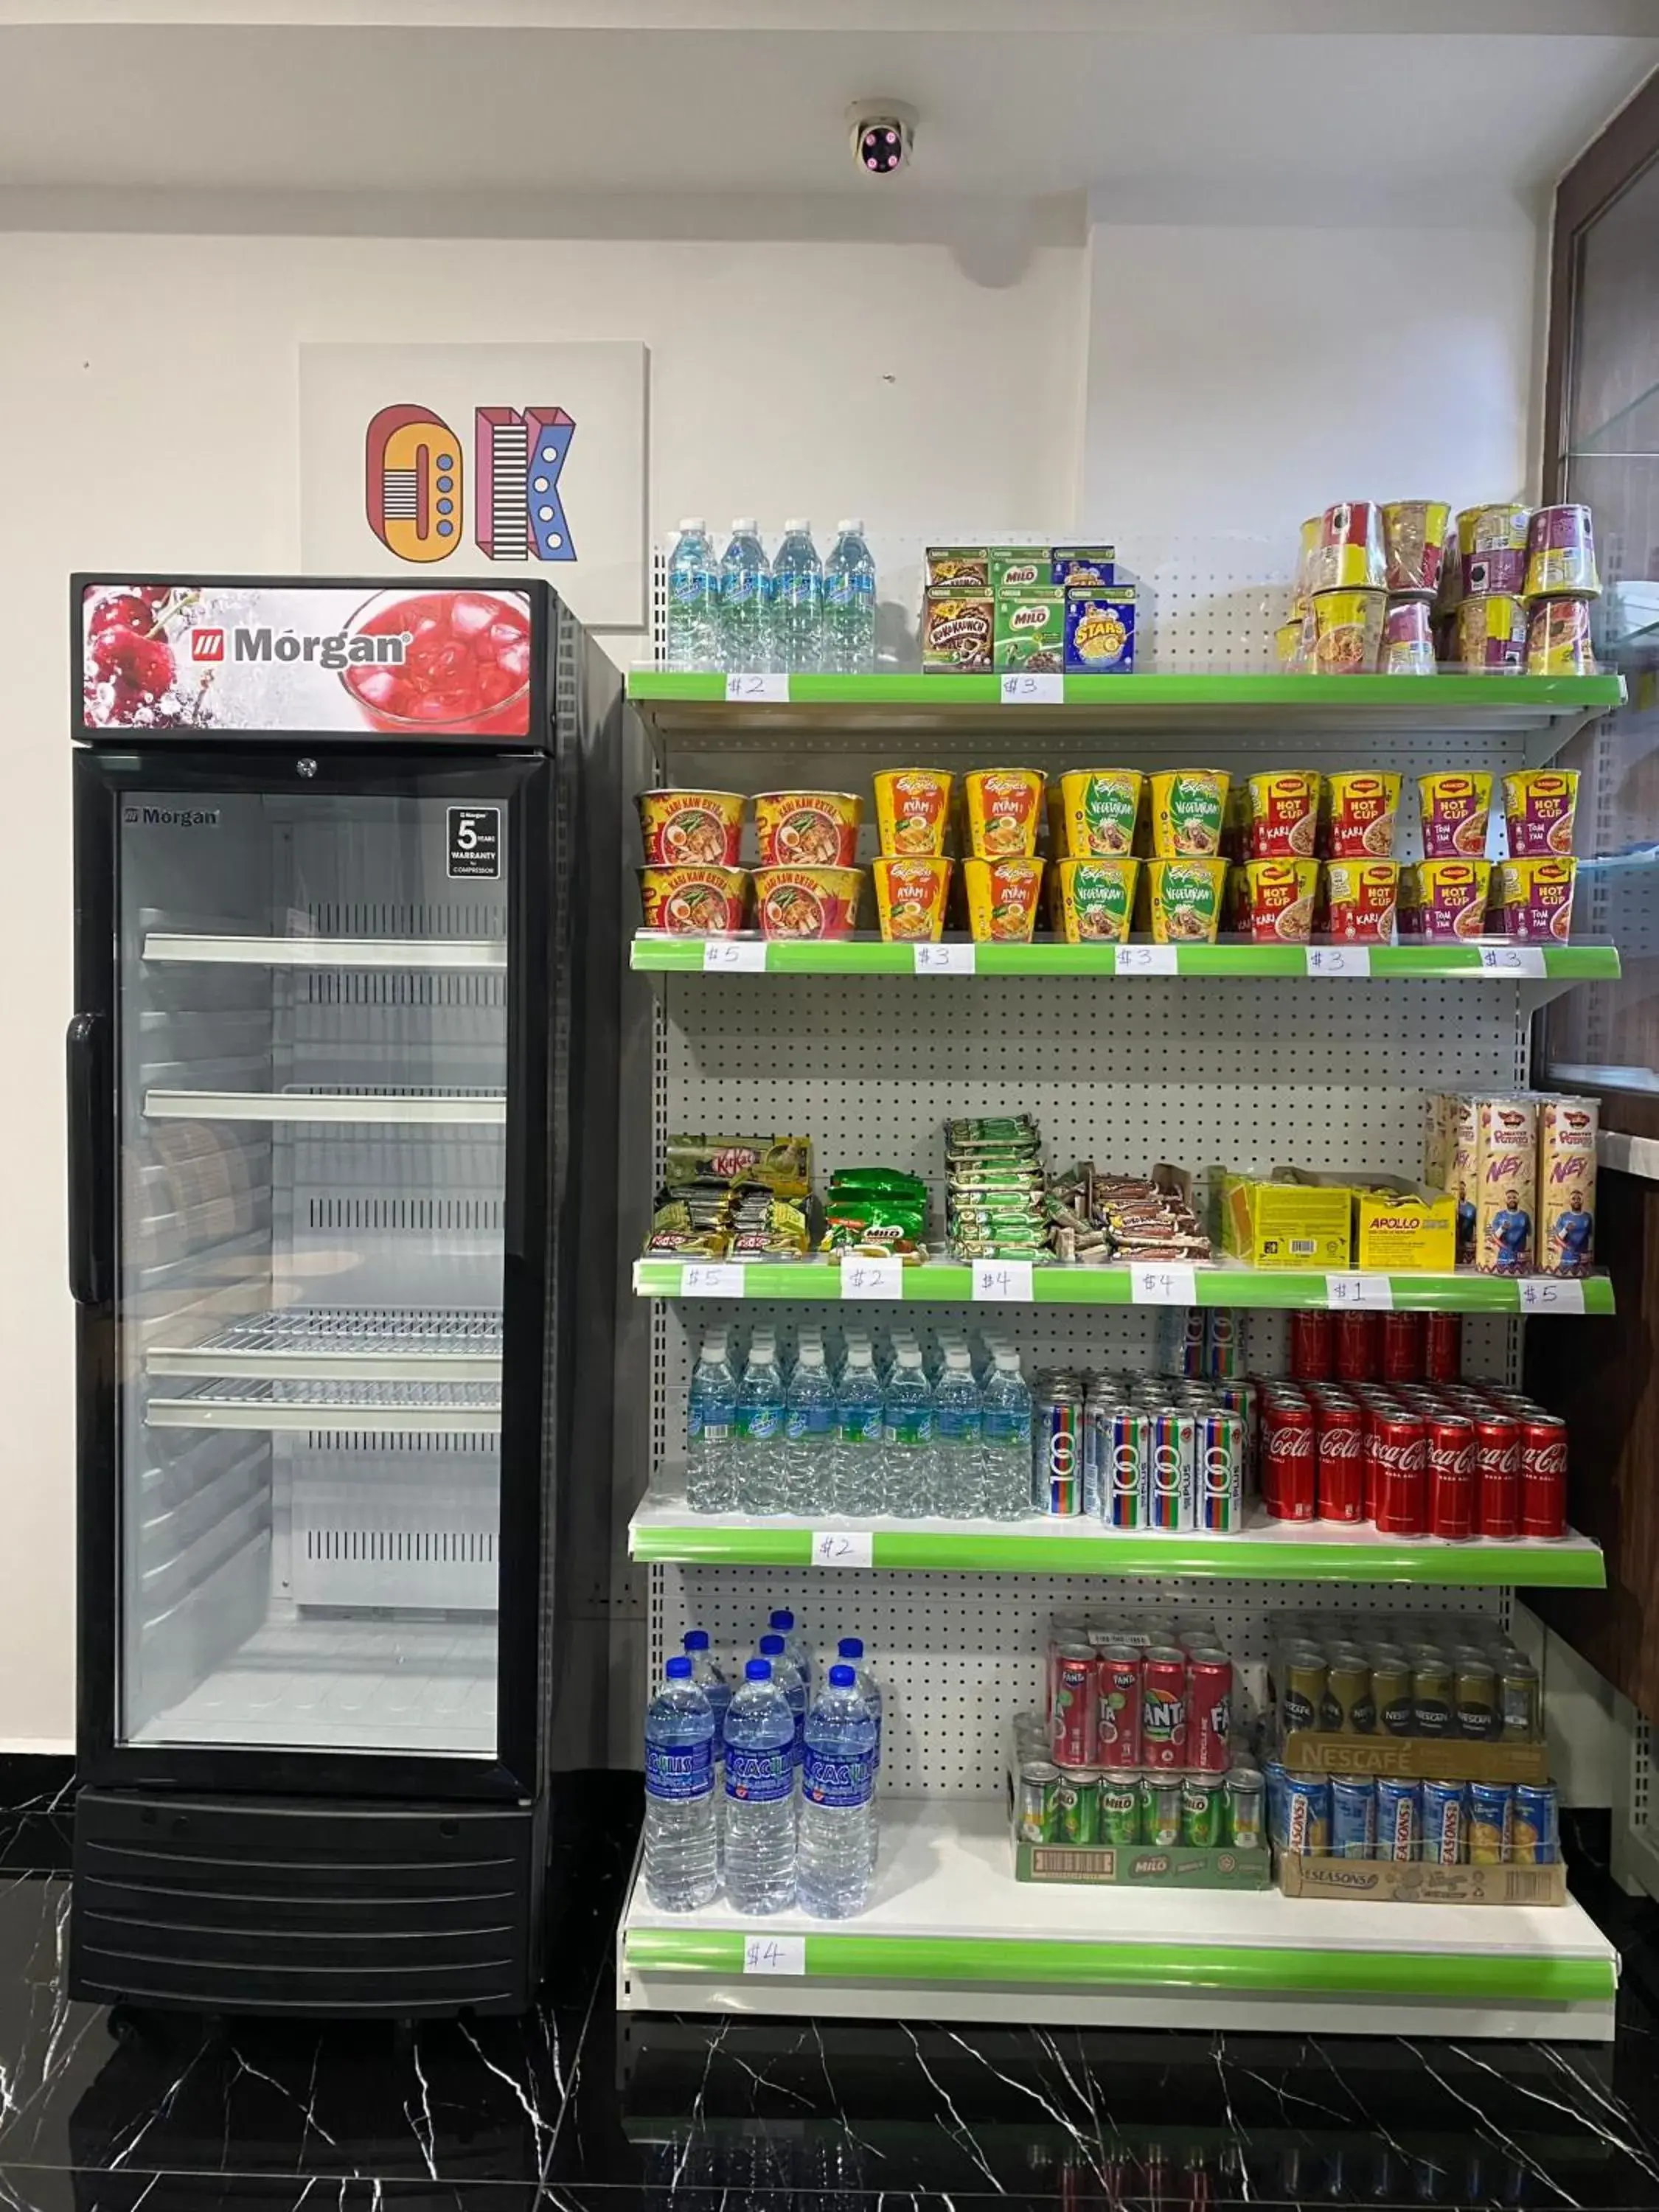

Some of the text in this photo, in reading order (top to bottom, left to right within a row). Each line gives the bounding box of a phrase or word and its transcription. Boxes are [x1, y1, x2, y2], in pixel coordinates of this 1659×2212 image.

[366, 403, 577, 563] OK
[1006, 570, 1034, 583] MILO
[1014, 611, 1047, 626] MILO
[1077, 622, 1123, 641] STARS
[1276, 800, 1301, 810] HOT
[1351, 800, 1377, 810] HOT
[1440, 799, 1467, 810] HOT
[1535, 799, 1561, 810] HOT
[1279, 810, 1303, 819] CUP
[1353, 810, 1378, 819] CUP
[1443, 810, 1468, 819] CUP
[1538, 810, 1562, 818] CUP
[457, 819, 477, 849] 5
[1267, 826, 1290, 838] KARI
[1341, 827, 1363, 839] KARI
[451, 851, 496, 860] WARRANTY
[1263, 887, 1289, 897] HOT
[1368, 888, 1390, 897] HOT
[1441, 887, 1468, 897] HOT
[1539, 886, 1564, 897] HOT
[1265, 897, 1290, 906] CUP
[1370, 897, 1391, 906] CUP
[1444, 897, 1470, 906] CUP
[1541, 897, 1565, 905] CUP
[1256, 914, 1276, 925] KARI
[1356, 914, 1378, 925] KARI
[1368, 1217, 1420, 1229] APOLLO
[1301, 1741, 1413, 1771] NESCAFÉ
[1106, 1797, 1132, 1808] MILO
[1135, 1861, 1167, 1874] MILO
